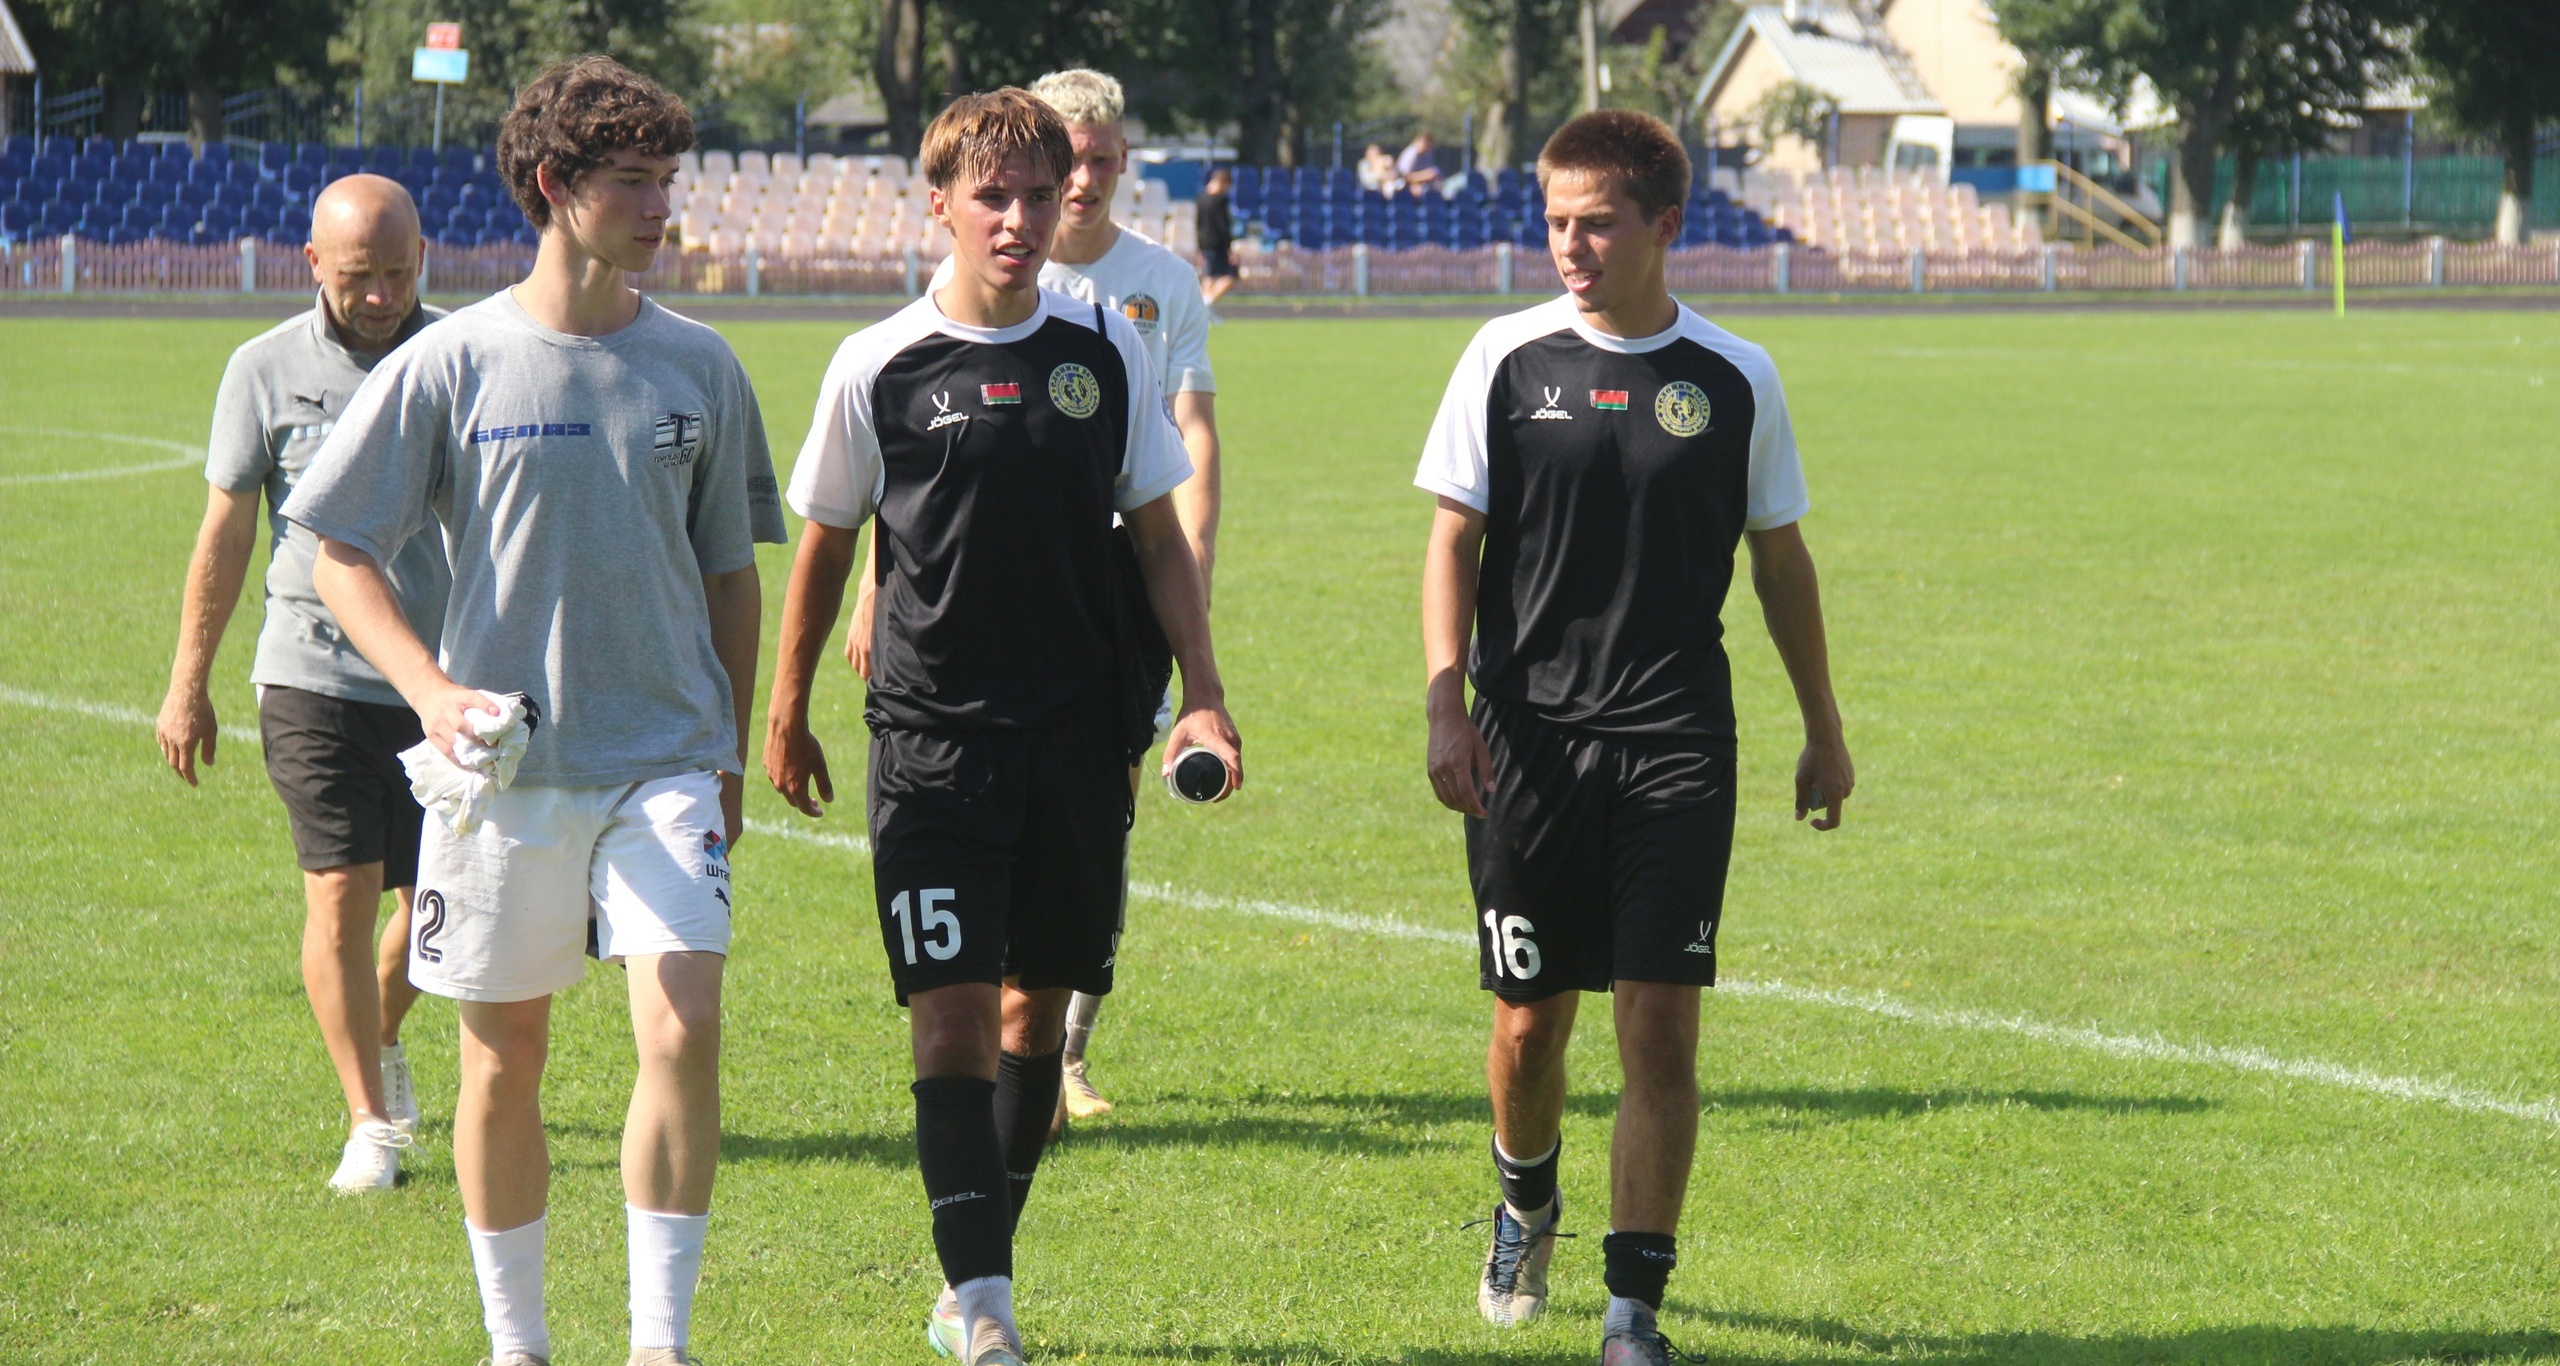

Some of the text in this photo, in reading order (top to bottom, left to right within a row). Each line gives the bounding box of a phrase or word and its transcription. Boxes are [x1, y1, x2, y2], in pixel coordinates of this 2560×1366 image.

[926, 411, 969, 431] JÖGEL
[1531, 408, 1573, 420] JÖGEL
[469, 423, 591, 444] БЕЛАЗ
[680, 446, 695, 465] 60
[416, 888, 446, 965] 2
[891, 888, 962, 966] 15
[1484, 908, 1542, 980] 16
[931, 1191, 986, 1211] ÖGEL
